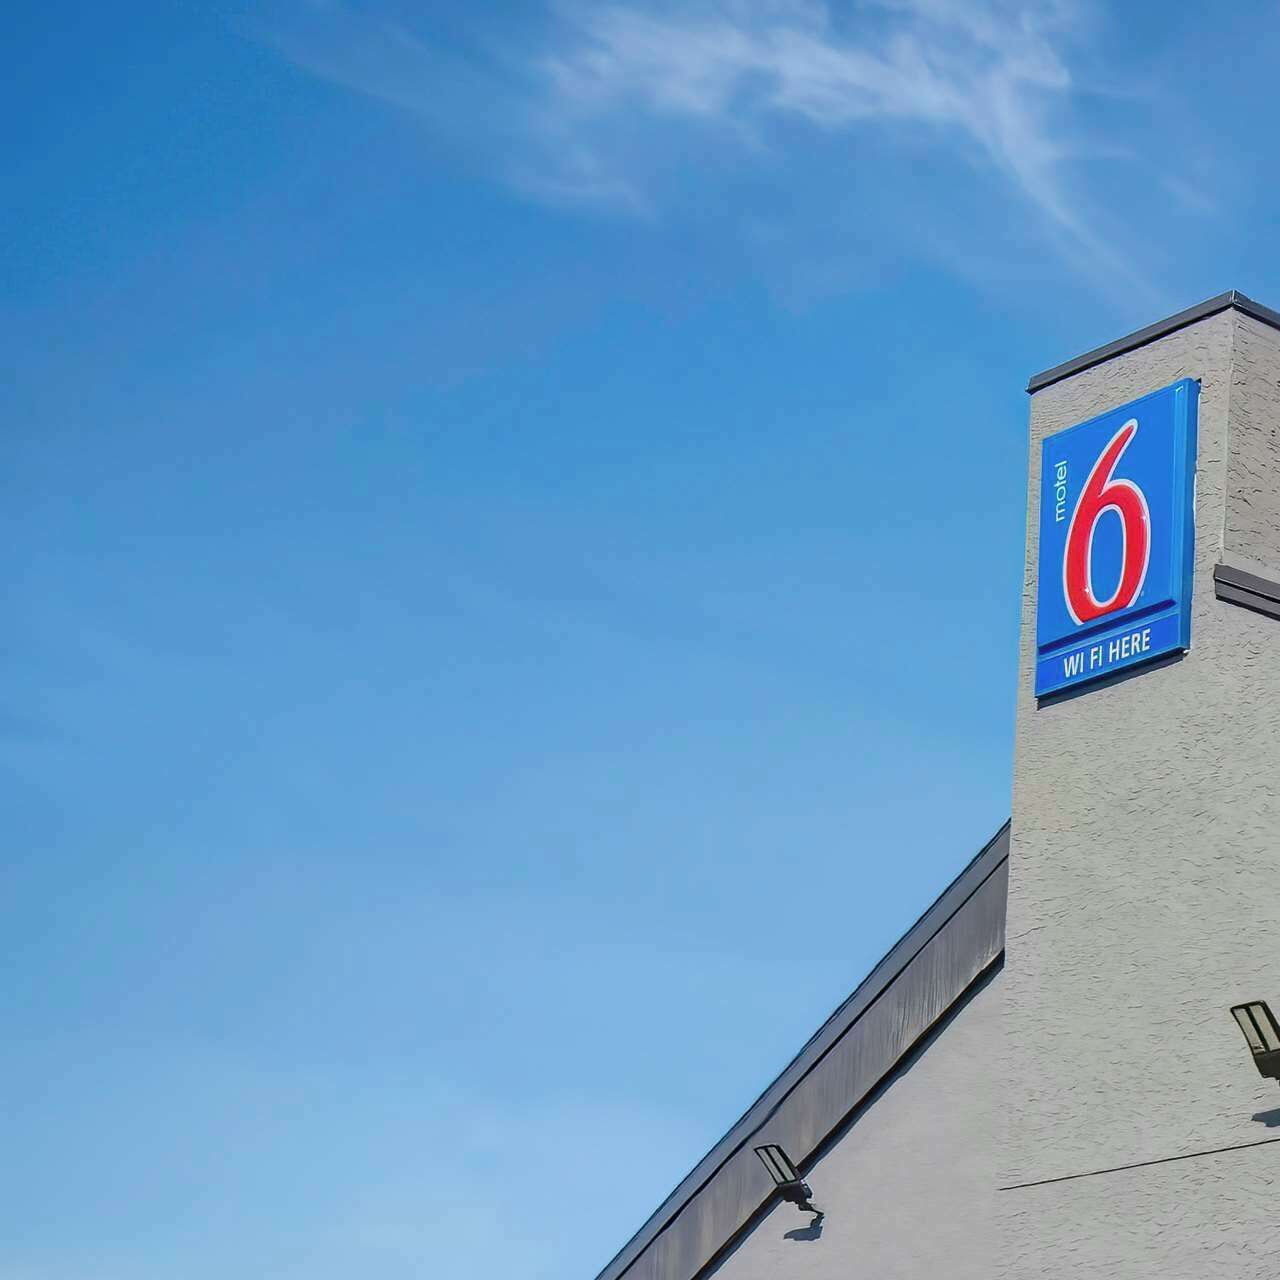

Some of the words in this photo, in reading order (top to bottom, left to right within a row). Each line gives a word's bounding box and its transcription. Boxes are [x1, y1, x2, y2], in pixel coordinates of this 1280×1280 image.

[1054, 460, 1068, 522] motel
[1063, 418, 1150, 625] 6
[1063, 651, 1085, 678] WI
[1090, 645, 1103, 670] FI
[1109, 628, 1151, 663] HERE
